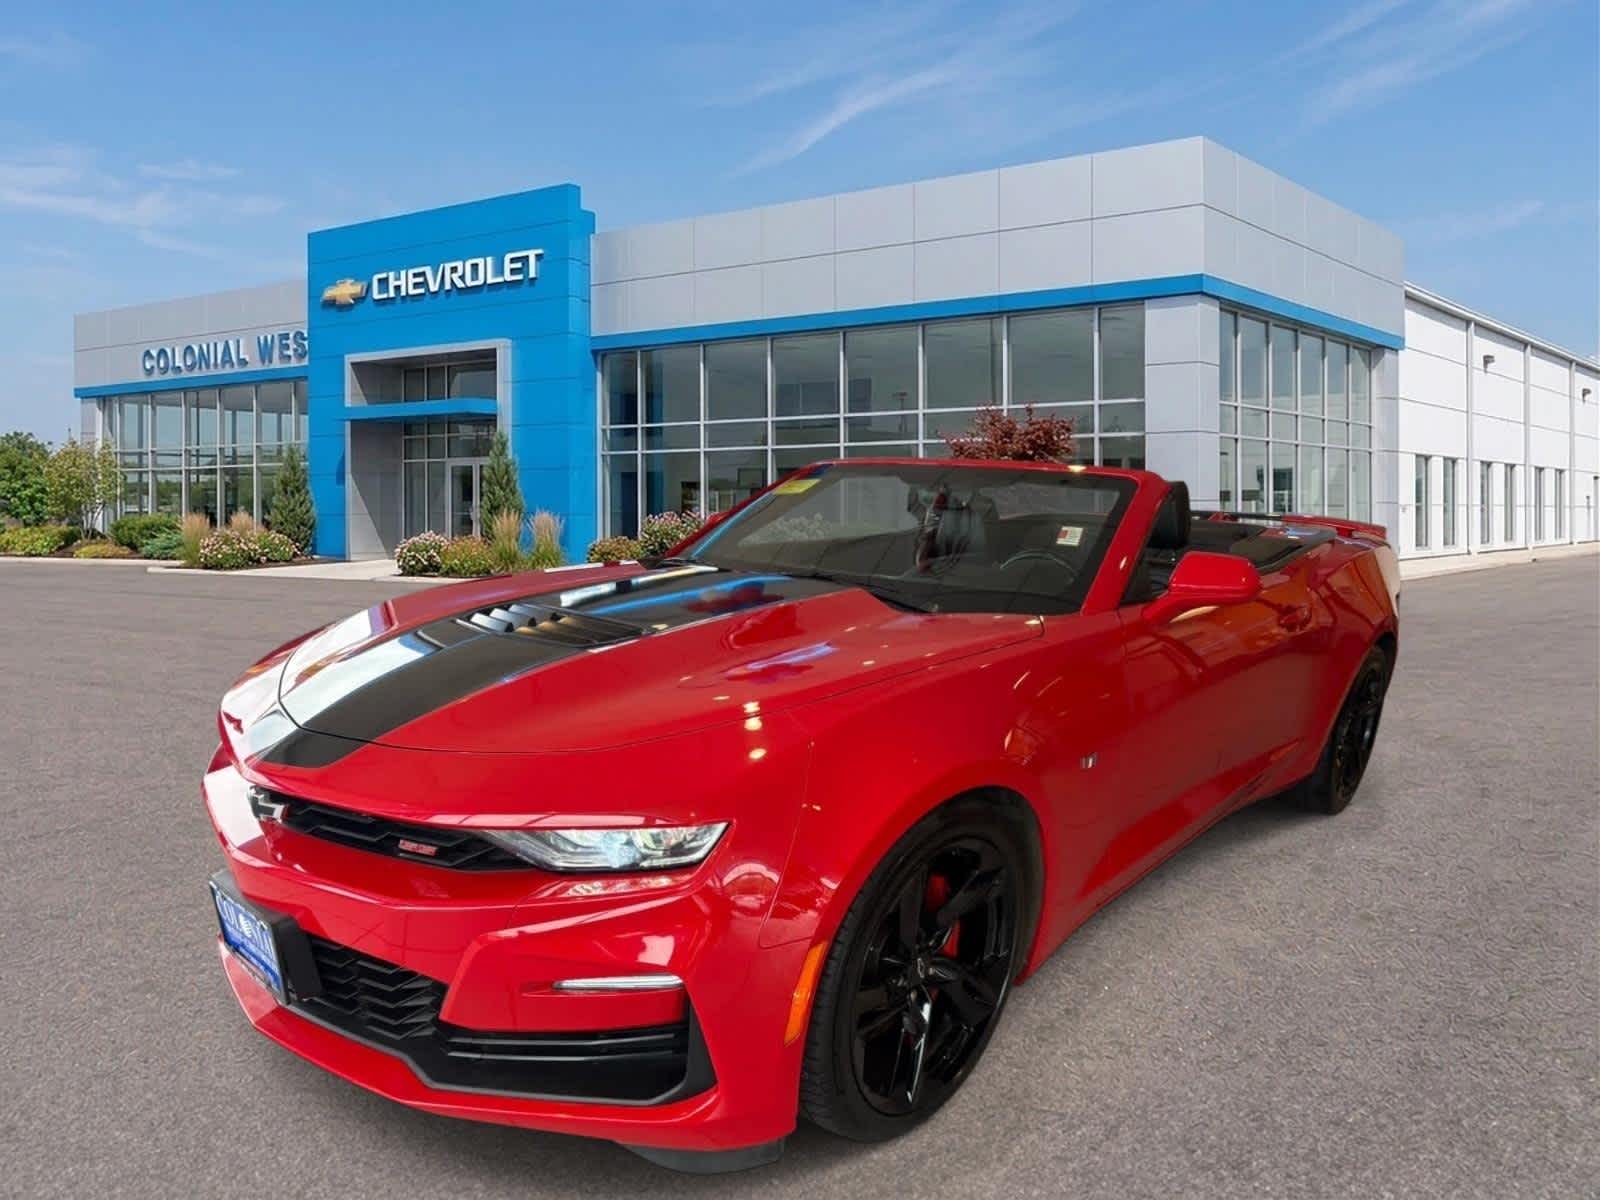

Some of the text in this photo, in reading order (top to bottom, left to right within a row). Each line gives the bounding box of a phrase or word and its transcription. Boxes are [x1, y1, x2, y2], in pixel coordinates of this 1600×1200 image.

[371, 248, 544, 301] CHEVROLET
[142, 330, 308, 376] COLONIAL WES
